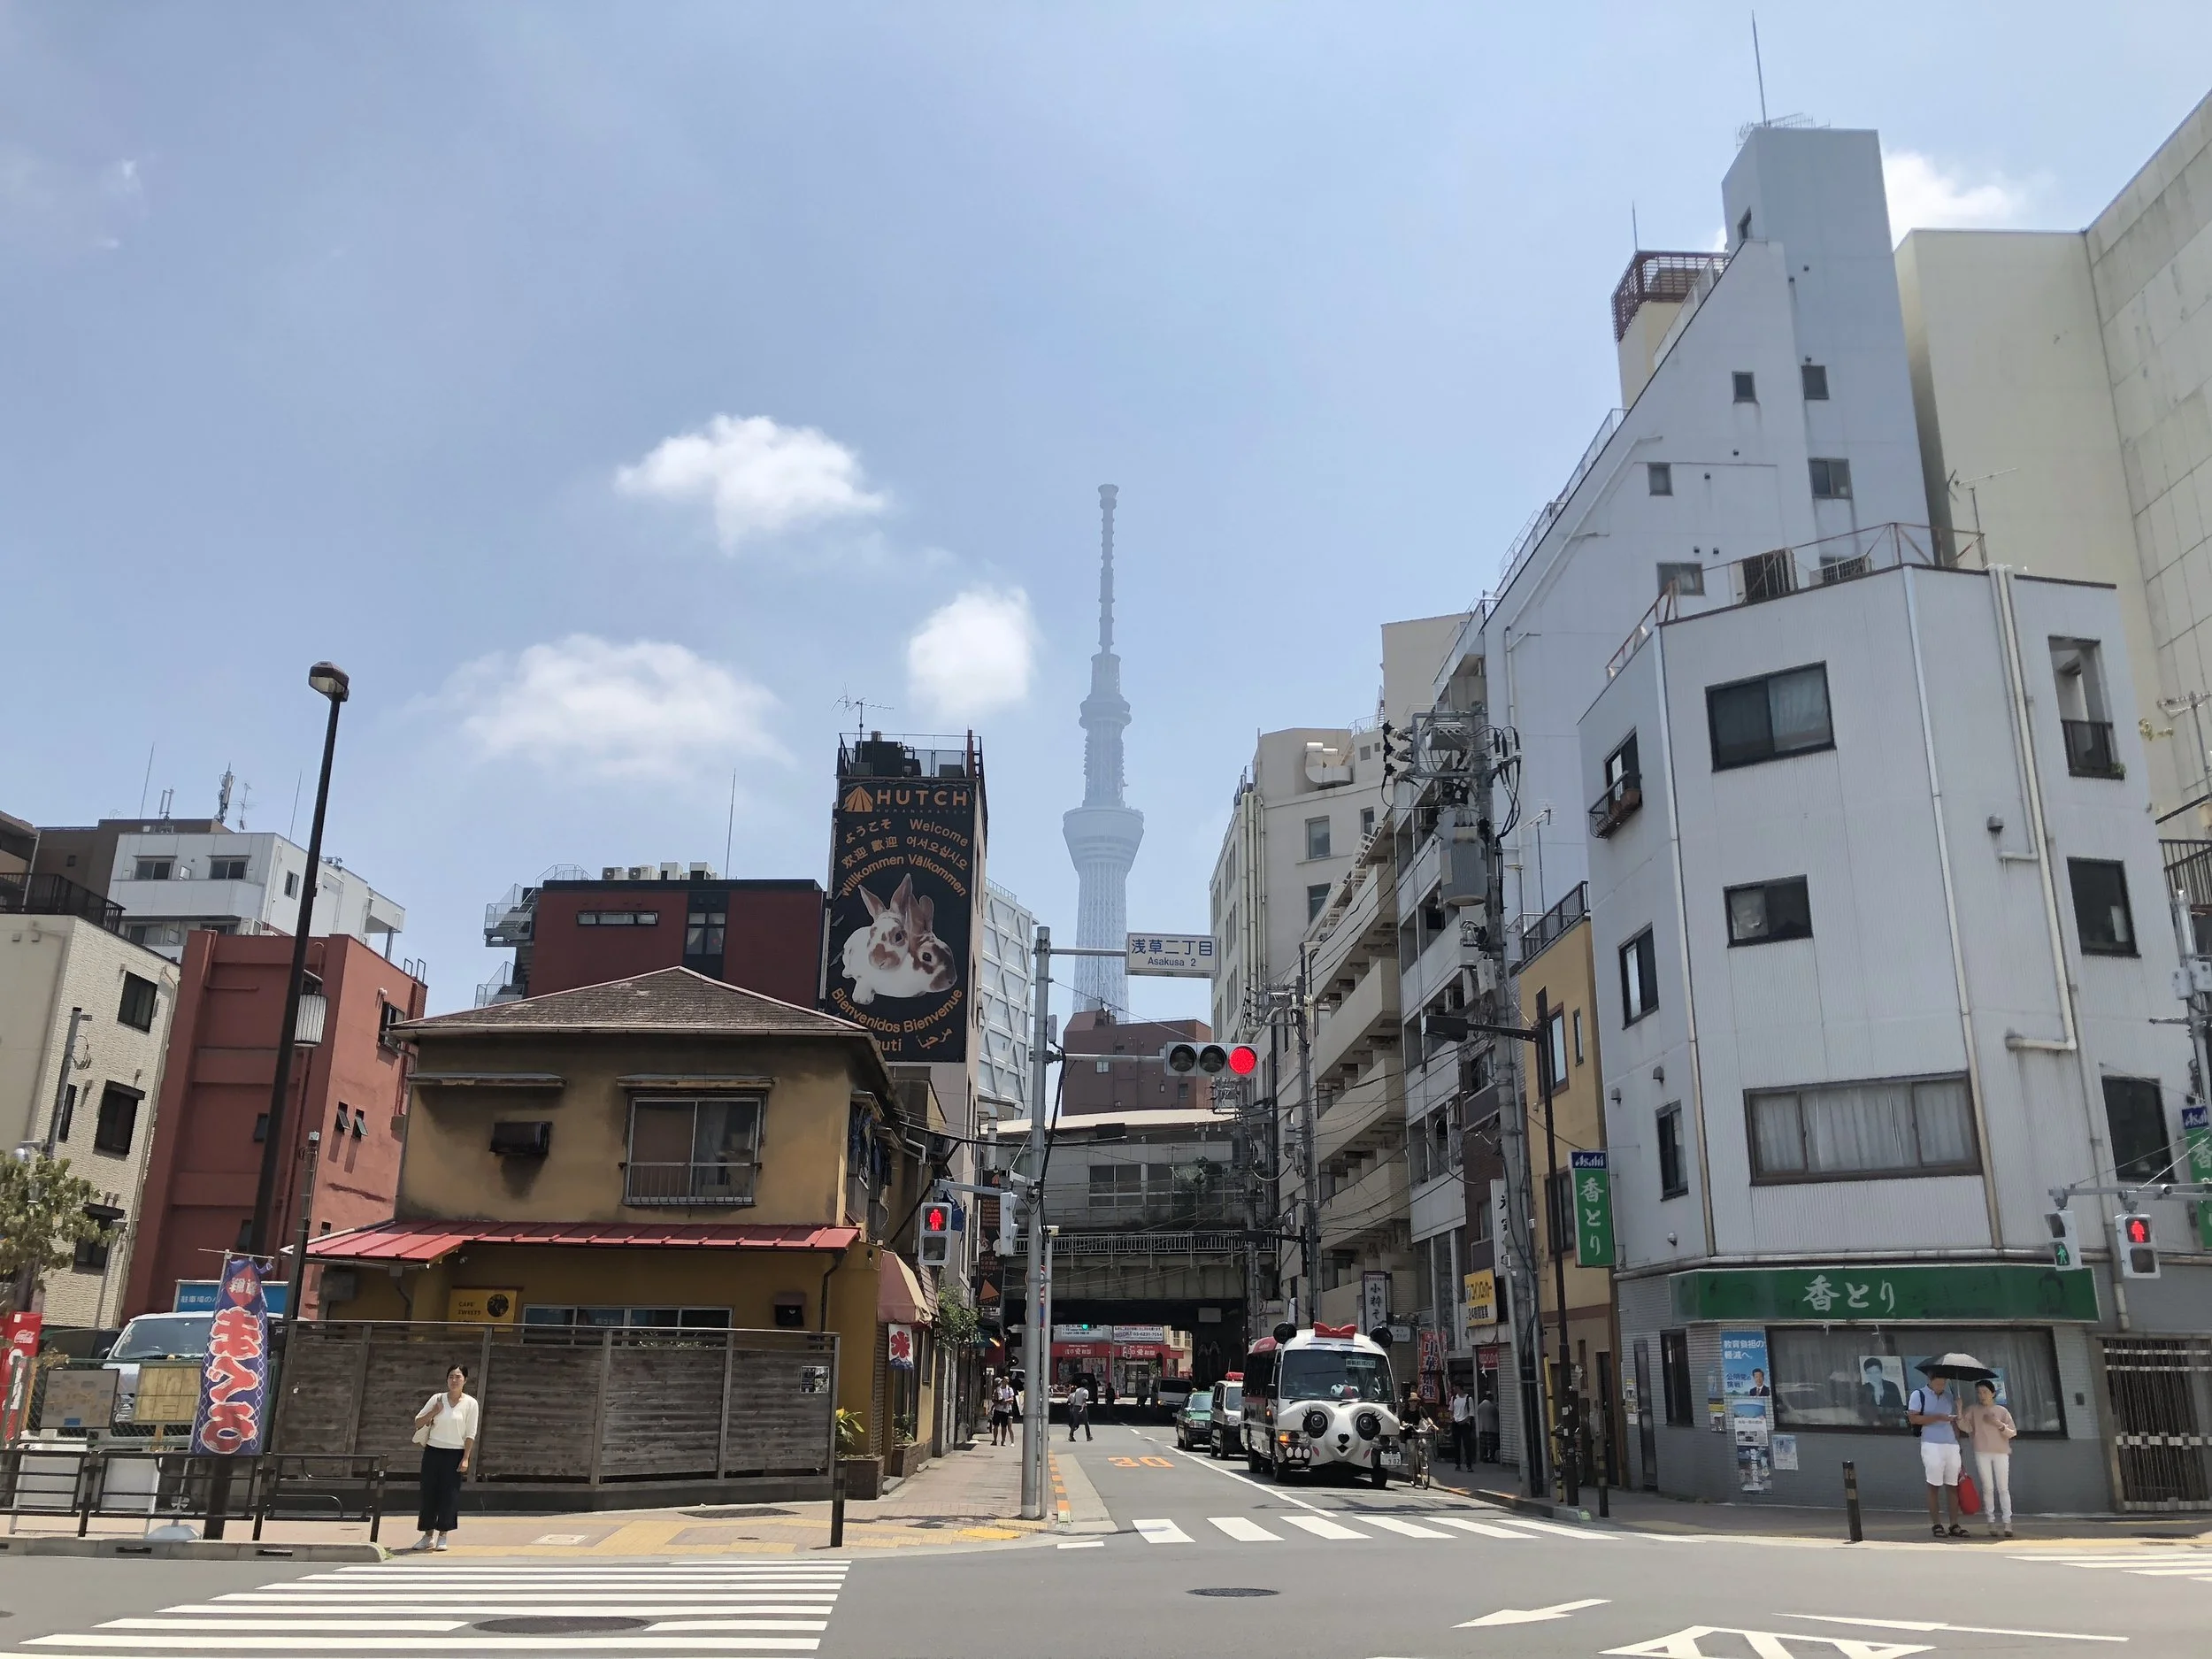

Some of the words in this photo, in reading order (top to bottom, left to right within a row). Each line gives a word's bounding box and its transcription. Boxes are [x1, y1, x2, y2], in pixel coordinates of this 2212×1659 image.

[877, 789, 967, 806] HUTCH
[845, 818, 892, 844] ようこそ
[910, 818, 968, 847] Welcome
[841, 846, 868, 869] 欢迎
[841, 855, 904, 897] Willkommen
[908, 854, 967, 897] Välkommen
[1131, 939, 1212, 956] 浅草二丁目
[1148, 956, 1185, 966] Asakusa
[1190, 958, 1196, 967] 2
[832, 987, 901, 1033] Bienvenidos
[903, 989, 963, 1033] Bienvenue
[1575, 1155, 1603, 1167] Asahi
[1579, 1177, 1605, 1256] 香とり
[1802, 1274, 1894, 1313] 香とり
[1724, 1340, 1764, 1348] 教育負担の
[1107, 1456, 1175, 1467] 30
